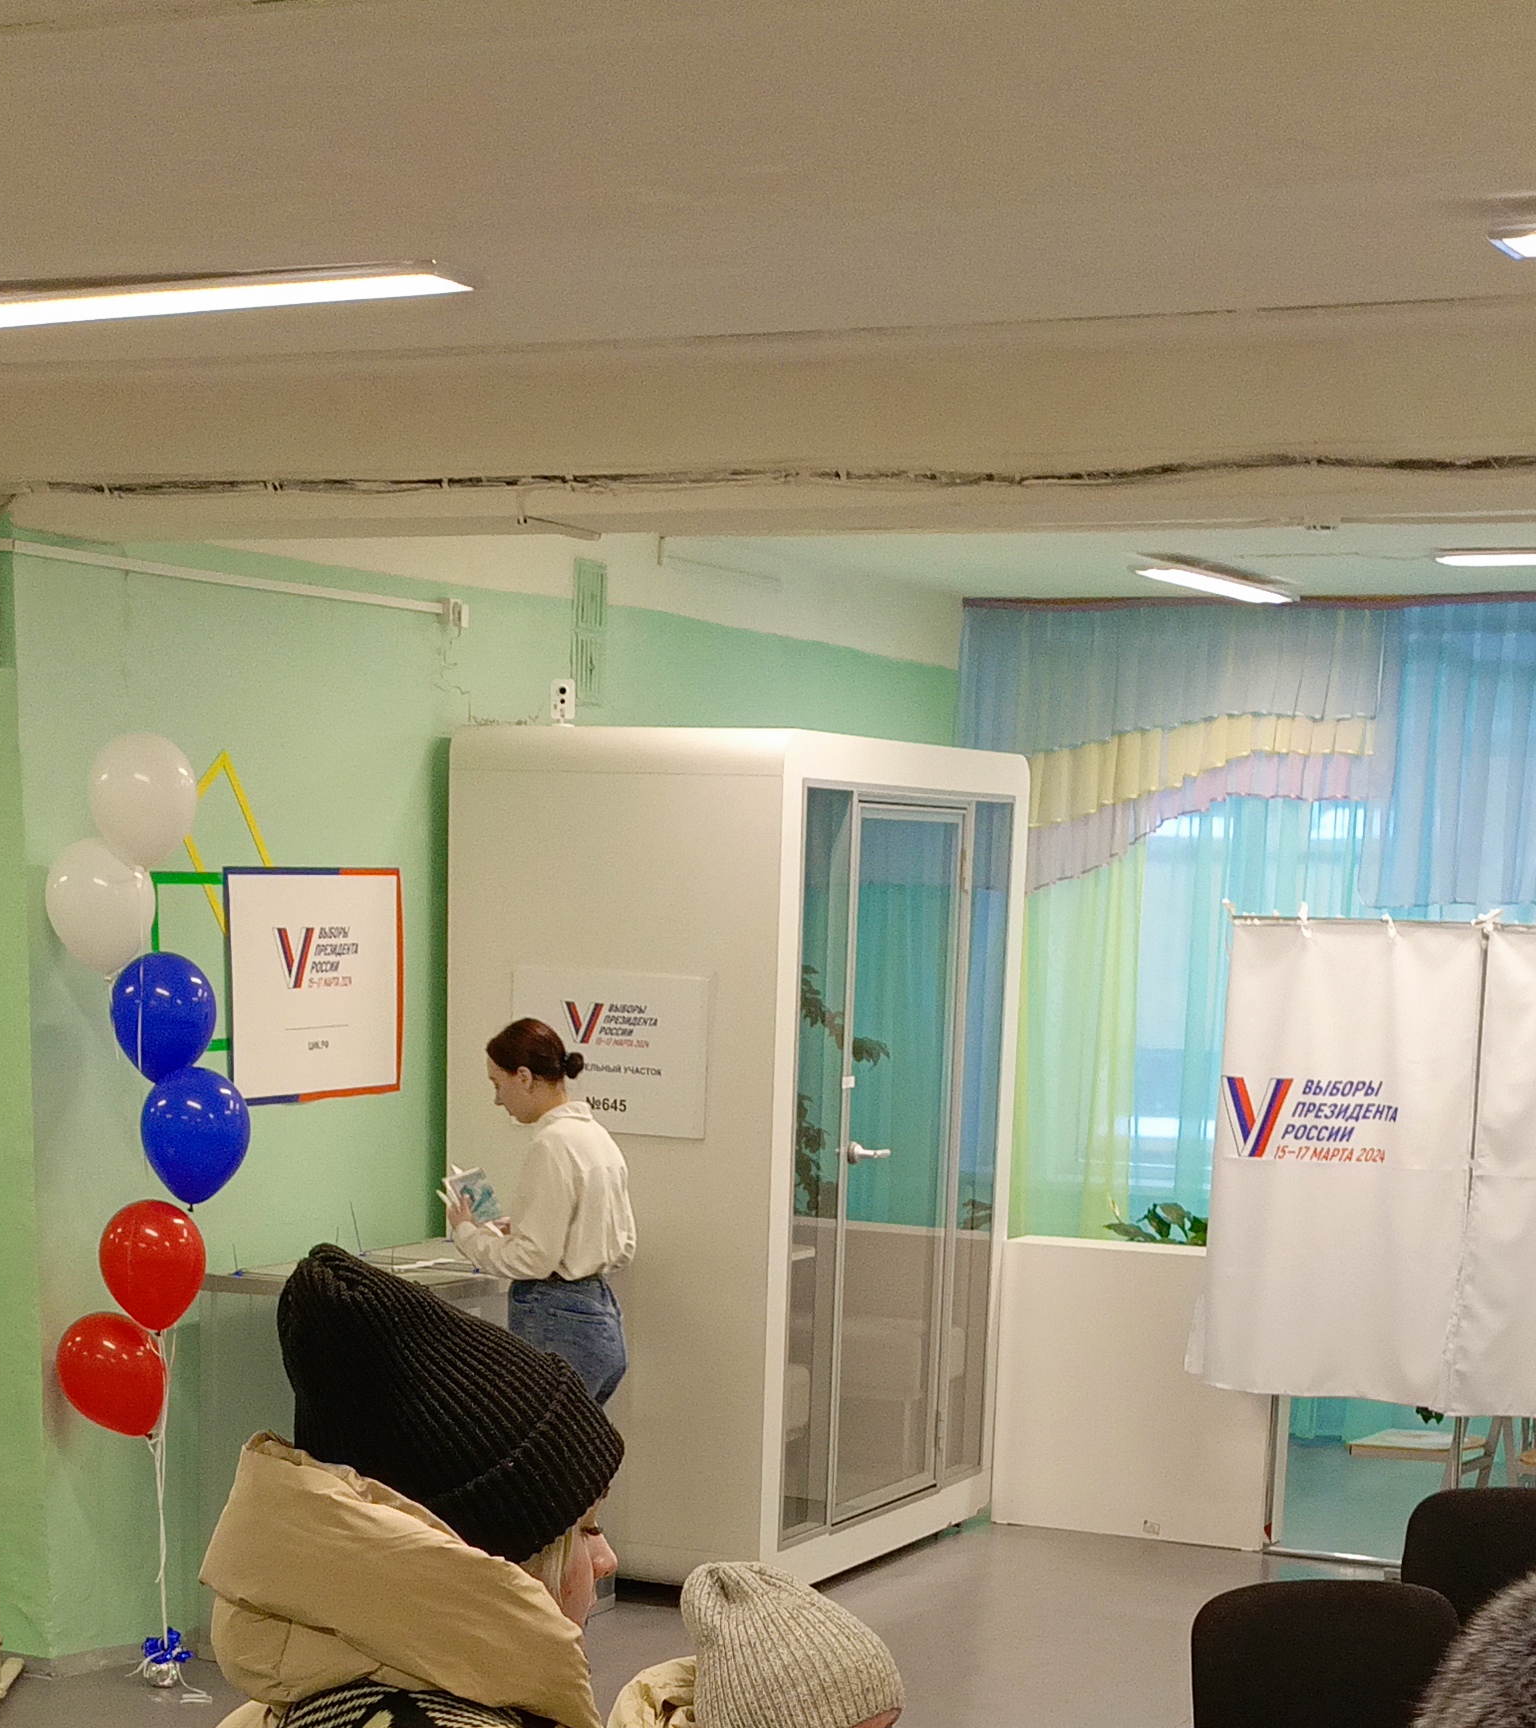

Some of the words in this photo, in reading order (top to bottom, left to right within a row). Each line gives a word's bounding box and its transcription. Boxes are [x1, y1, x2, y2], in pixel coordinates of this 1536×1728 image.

[318, 926, 351, 939] ВЫБОРЫ
[314, 942, 359, 957] ПРЕЗИДЕНТА
[310, 960, 341, 974] РОССИИ
[608, 1003, 648, 1015] ВЫБОРЫ
[603, 1014, 658, 1027] ПРЕЗИДЕНТА
[598, 1026, 634, 1037] РОССИИ
[623, 1065, 662, 1077] УЧАСТОК
[1302, 1078, 1383, 1098] ВЫБОРЫ
[586, 1095, 627, 1113] №645
[1291, 1101, 1400, 1123] ПРЕЗИДЕНТА
[1281, 1123, 1356, 1143] РОССИИ
[1309, 1147, 1353, 1162] МАРТА
[1355, 1149, 1386, 1164] 2024
